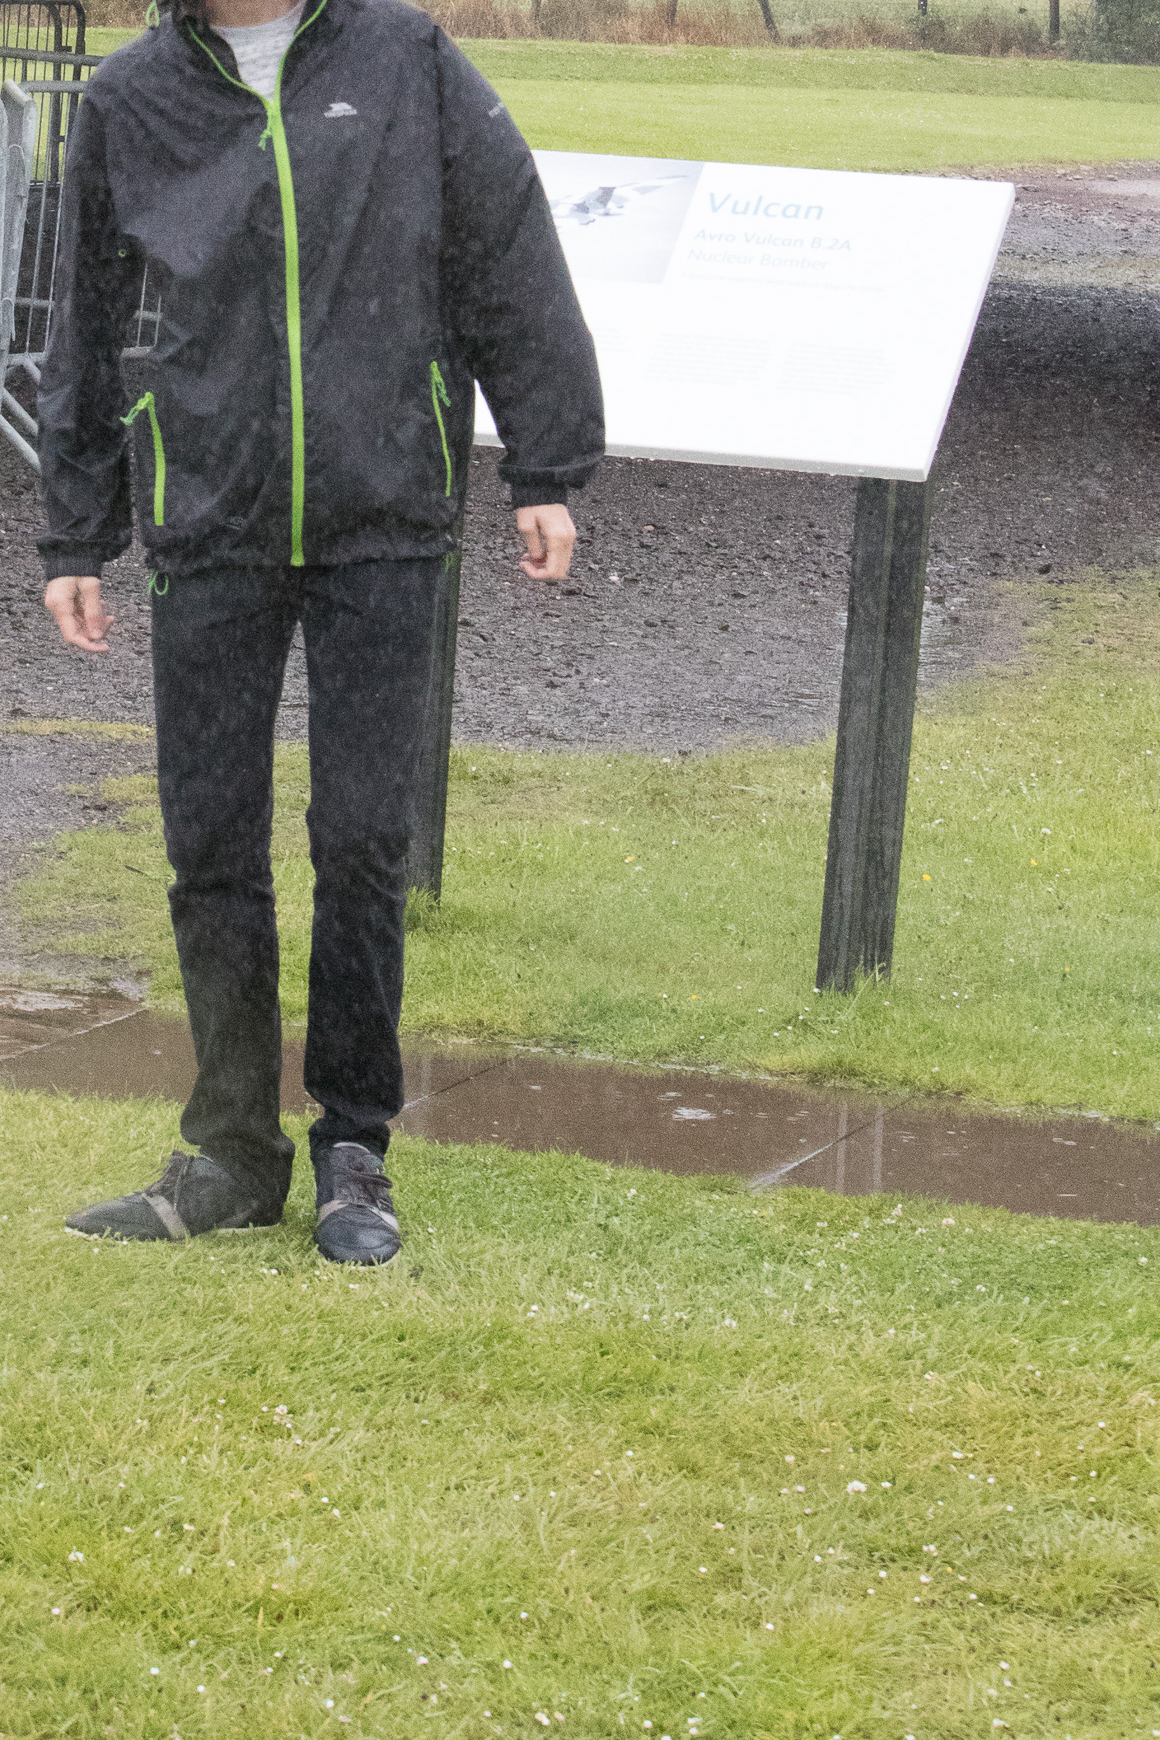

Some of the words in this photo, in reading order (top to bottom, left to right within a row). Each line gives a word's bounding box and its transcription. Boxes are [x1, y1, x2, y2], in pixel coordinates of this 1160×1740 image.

[708, 191, 824, 221] Vulcan
[693, 228, 737, 244] Avro
[743, 231, 805, 248] Vulcan
[810, 236, 852, 252] B.2A
[687, 249, 755, 266] Nuclear
[760, 253, 830, 272] Bomber
